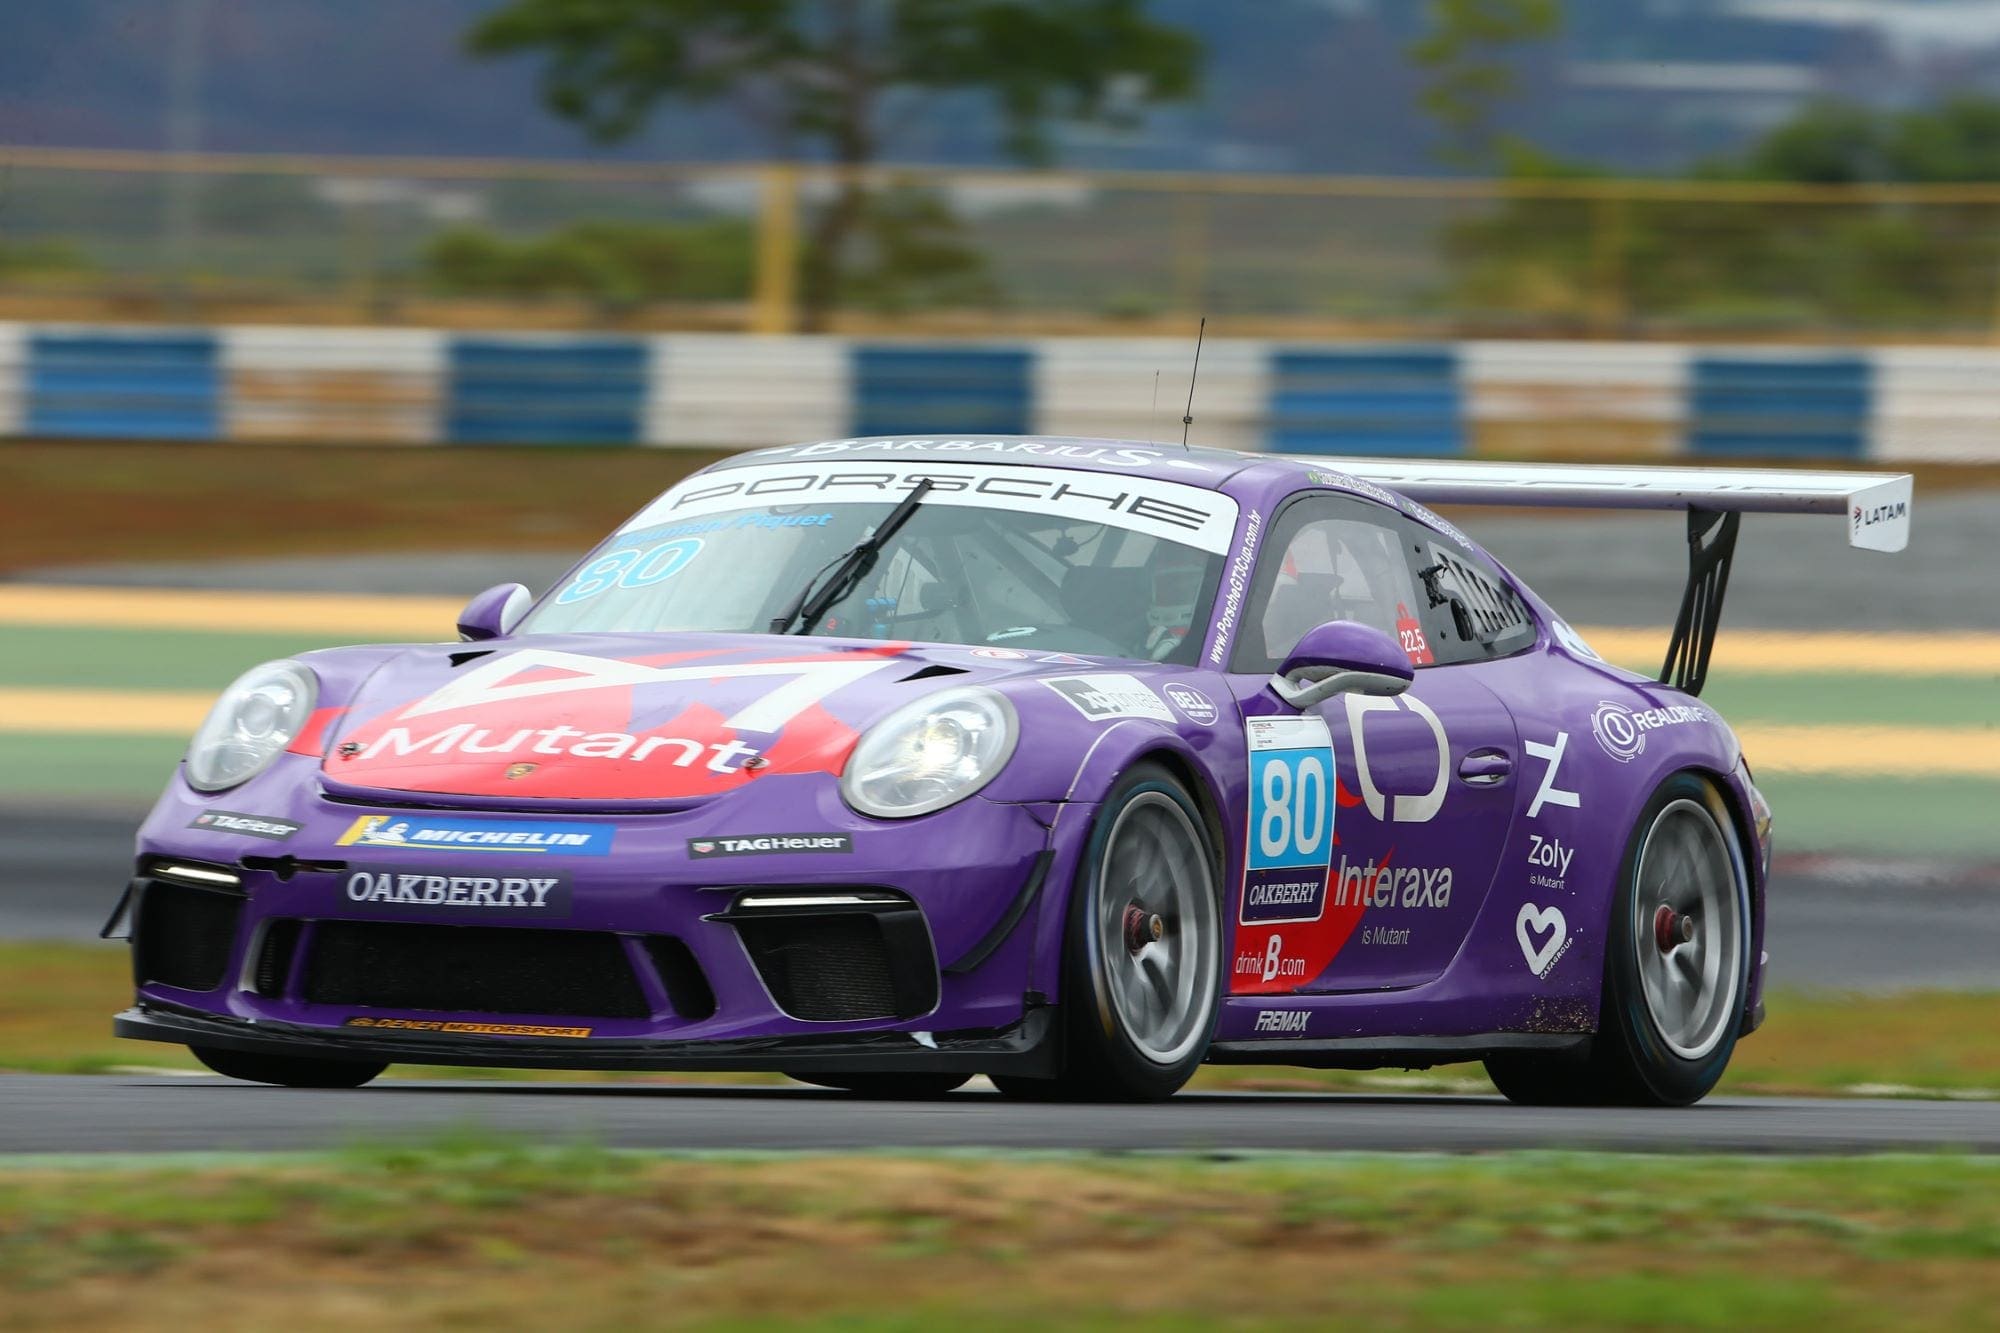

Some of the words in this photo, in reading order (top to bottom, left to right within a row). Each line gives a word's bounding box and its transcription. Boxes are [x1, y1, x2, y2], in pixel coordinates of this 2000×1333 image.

[790, 439, 1163, 467] BARBARIUS
[671, 473, 1212, 531] PORSCHE
[1865, 502, 1906, 525] LATAM
[555, 537, 705, 605] 80
[1209, 509, 1263, 665] www.PorscheGT3Cup.com.br
[1400, 628, 1426, 654] 22,5
[1168, 691, 1214, 709] BELL
[358, 723, 760, 775] Mutant
[1260, 756, 1326, 858] 80
[412, 828, 592, 847] MICHELIN
[1528, 834, 1574, 878] Zoly
[347, 871, 559, 908] OAKBERRY
[1249, 882, 1320, 906] OAKBERRY
[1333, 854, 1453, 909] Interaxa
[1529, 873, 1536, 885] is
[1537, 875, 1565, 890] Mutant
[1361, 926, 1373, 945] is
[1373, 926, 1410, 946] Mutant
[374, 1018, 443, 1031] DENER
[444, 1022, 588, 1036] MOTORSPORT
[1254, 1010, 1312, 1031] FREMAX
